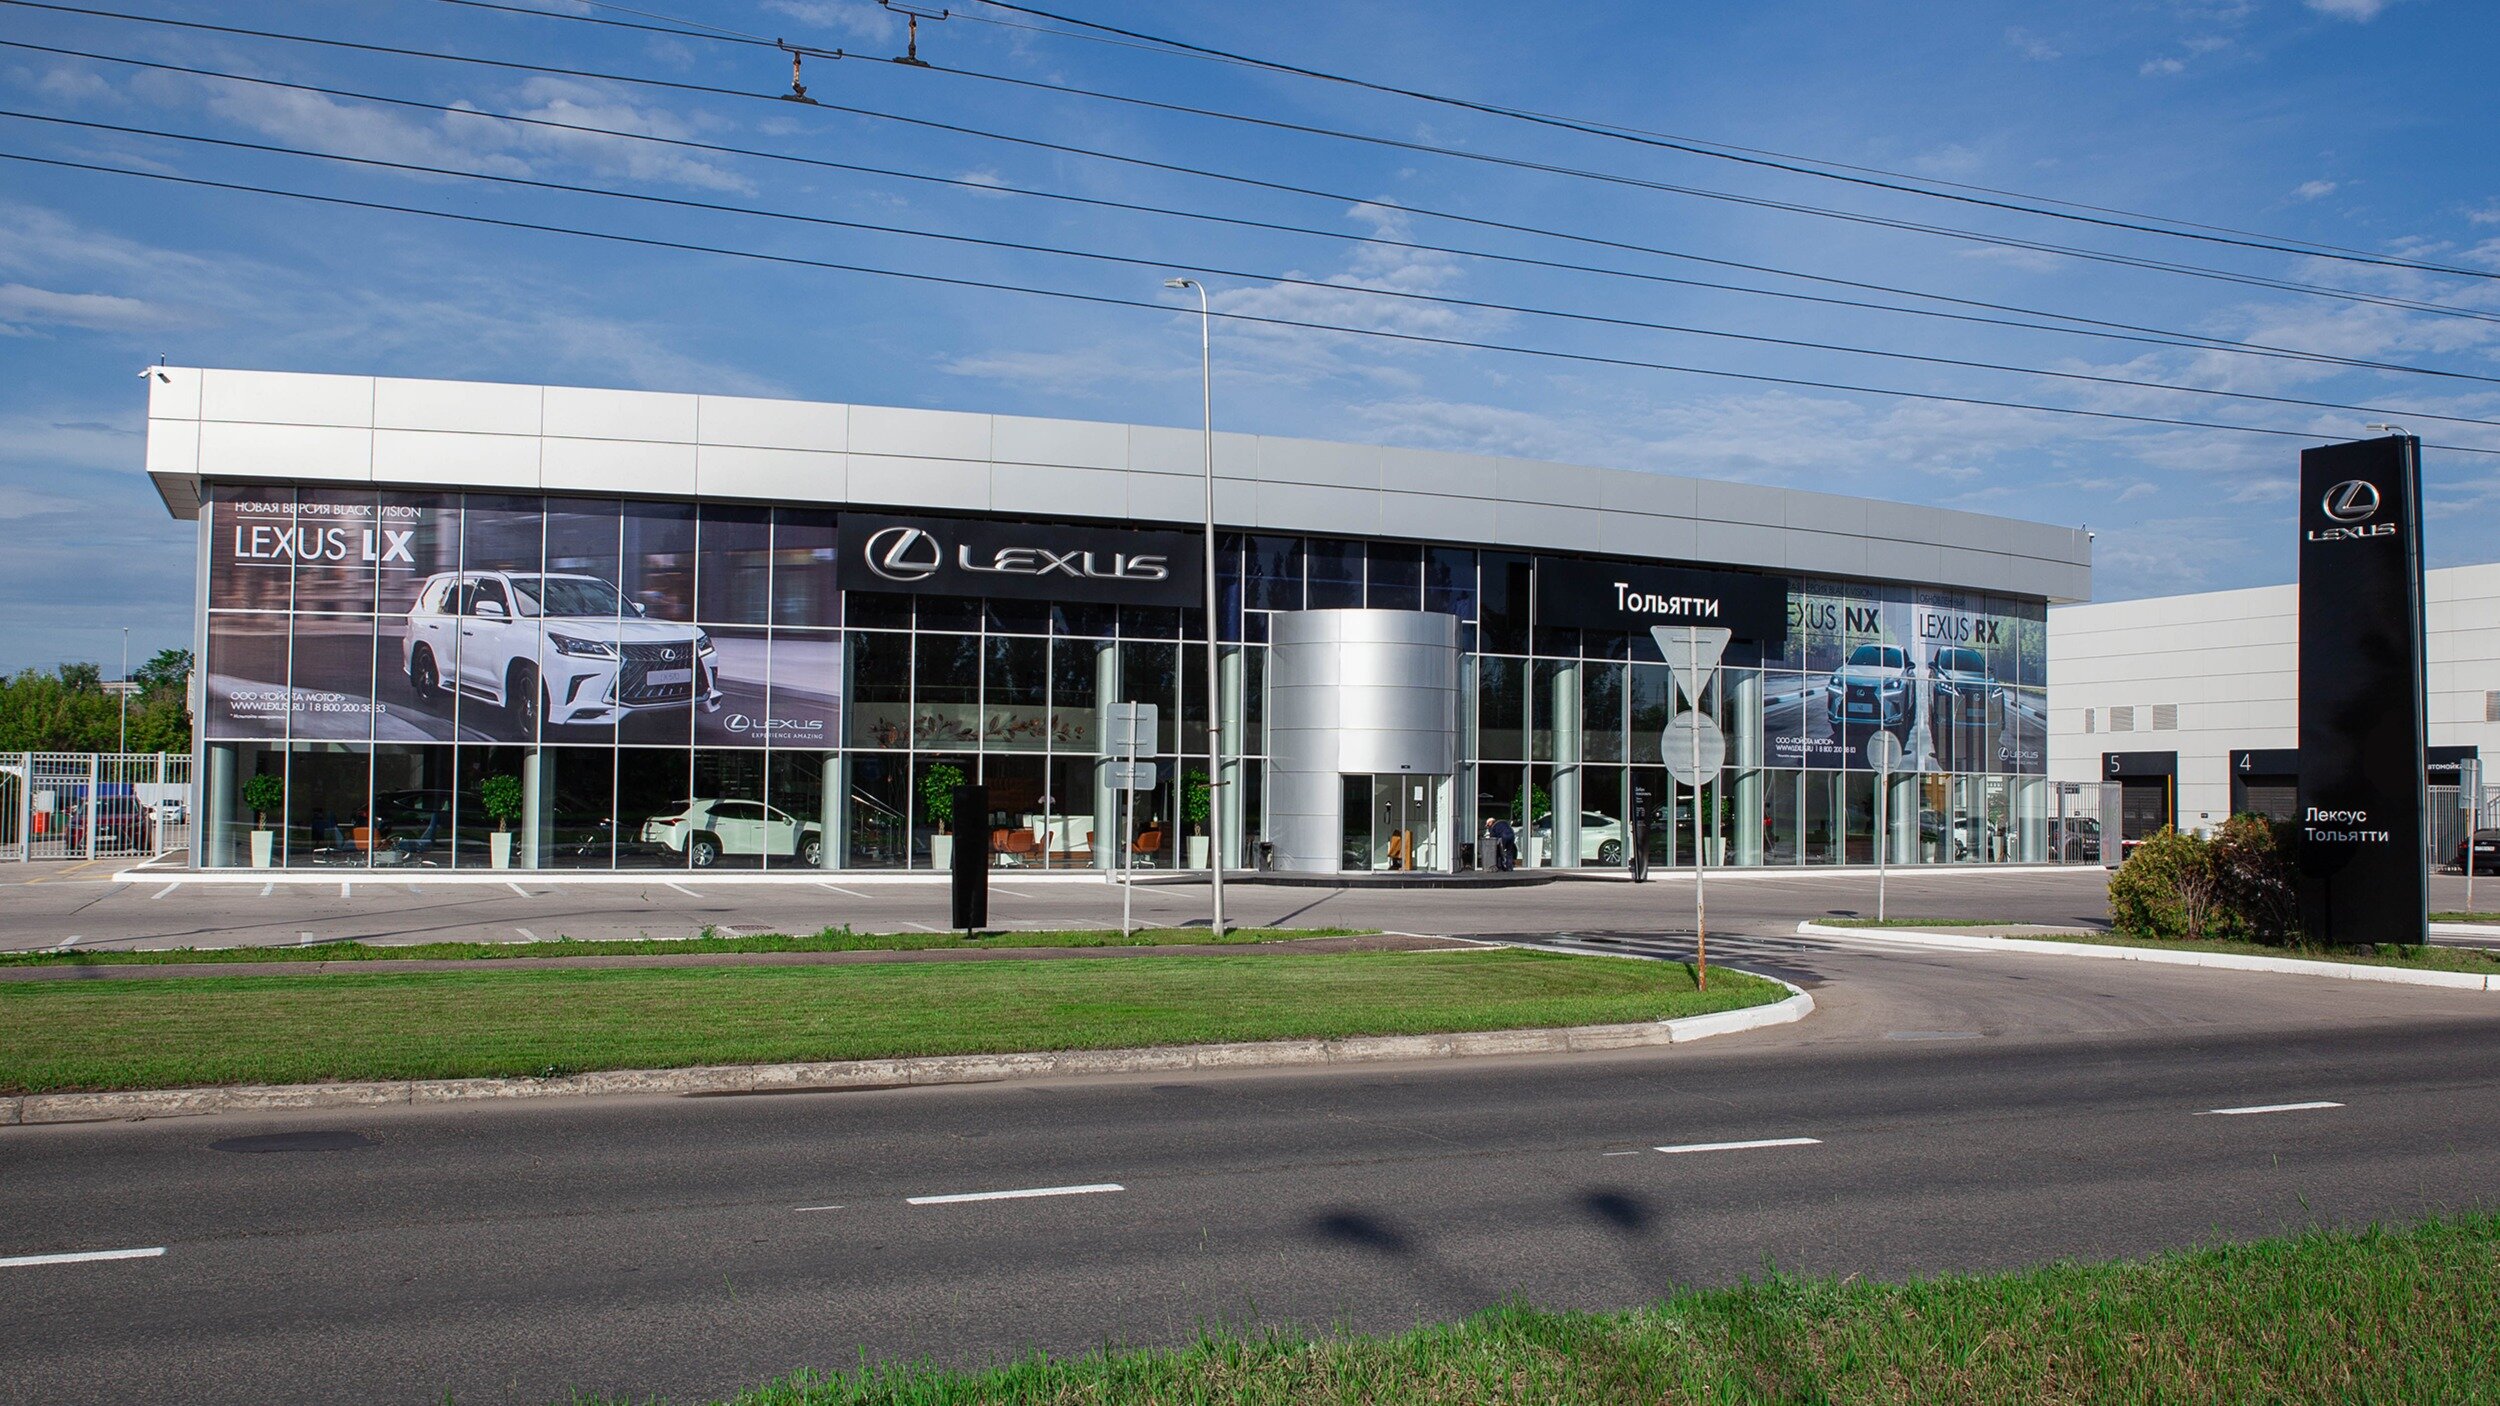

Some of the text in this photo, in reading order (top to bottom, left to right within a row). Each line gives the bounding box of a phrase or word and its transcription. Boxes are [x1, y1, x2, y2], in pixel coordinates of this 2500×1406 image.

[234, 501, 422, 518] НОВАЯ ВЕРСИЯ BLACK VISION
[2307, 522, 2396, 541] LEXUS
[234, 525, 415, 562] LEXUS LX
[959, 544, 1169, 581] LEXUS
[1614, 582, 1719, 617] Тольятти
[1787, 602, 1880, 634] EXUS NX
[1920, 613, 2000, 645] LEXUS RX
[230, 691, 257, 700] ООО
[314, 703, 321, 712] 8
[322, 703, 341, 712] 800
[342, 703, 360, 712] 200
[752, 719, 823, 730] LEXUS
[2010, 751, 2039, 759] LEXUS
[2110, 755, 2121, 773] 5
[2239, 753, 2252, 771] 4
[2428, 762, 2462, 770] втомойк
[2305, 807, 2367, 825] Лексус
[2304, 827, 2389, 842] Тольятти
